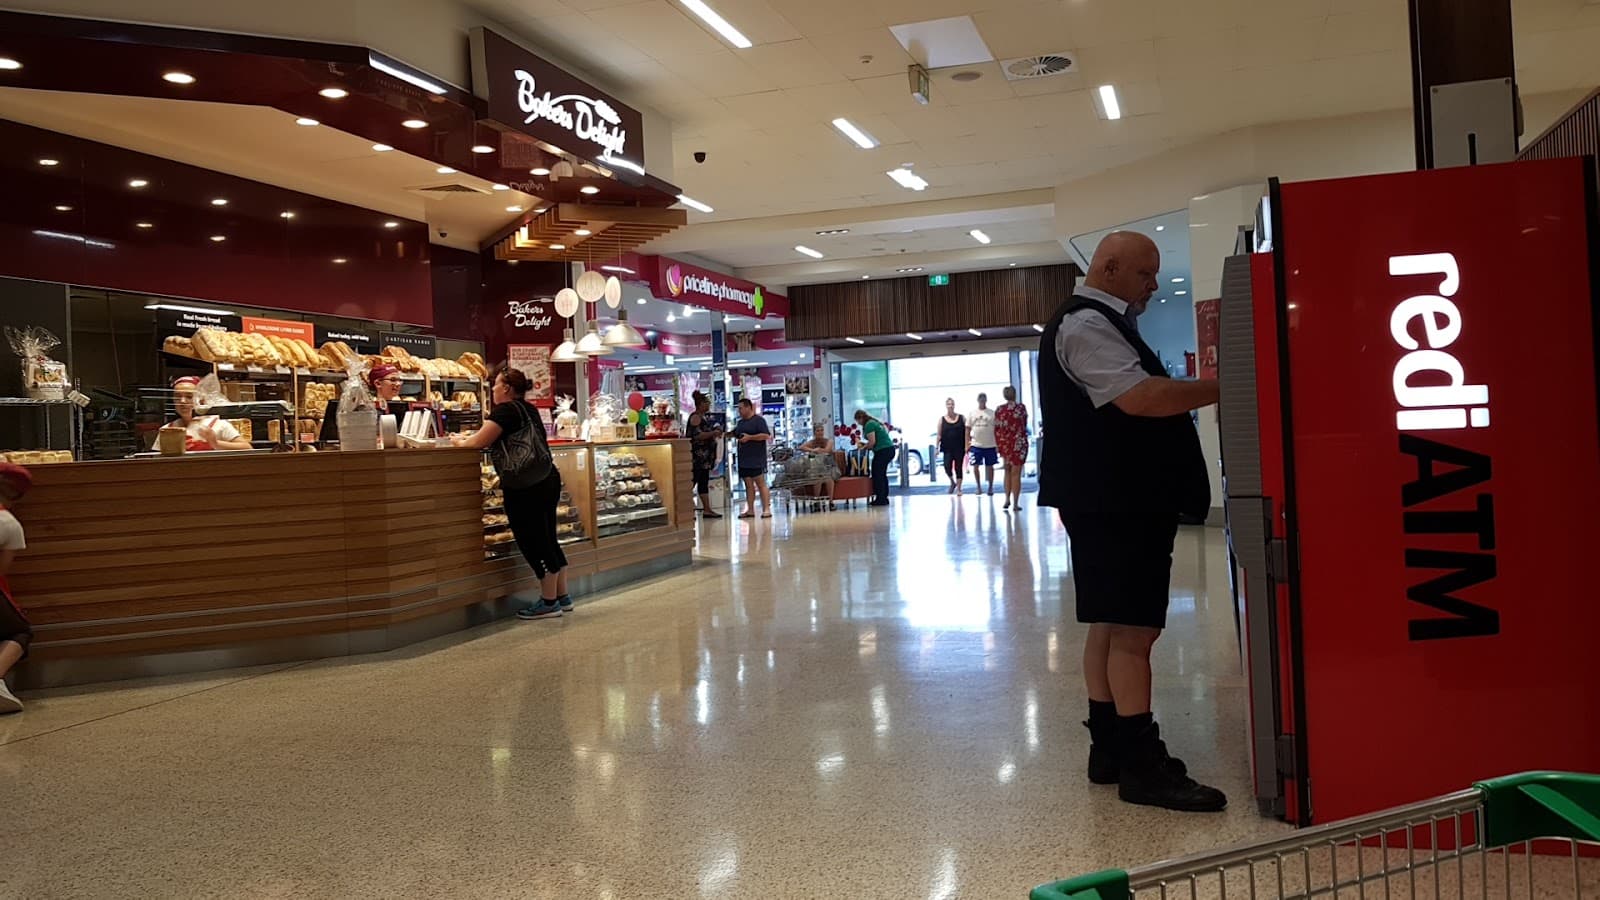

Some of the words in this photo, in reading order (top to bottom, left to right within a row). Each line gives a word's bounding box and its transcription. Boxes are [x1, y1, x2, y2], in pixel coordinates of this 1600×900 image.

[514, 70, 573, 130] Bakers
[576, 101, 626, 160] Delight
[684, 274, 718, 297] priceline
[719, 281, 755, 309] pharmacy
[508, 301, 543, 315] Bakers
[515, 314, 551, 330] Delight
